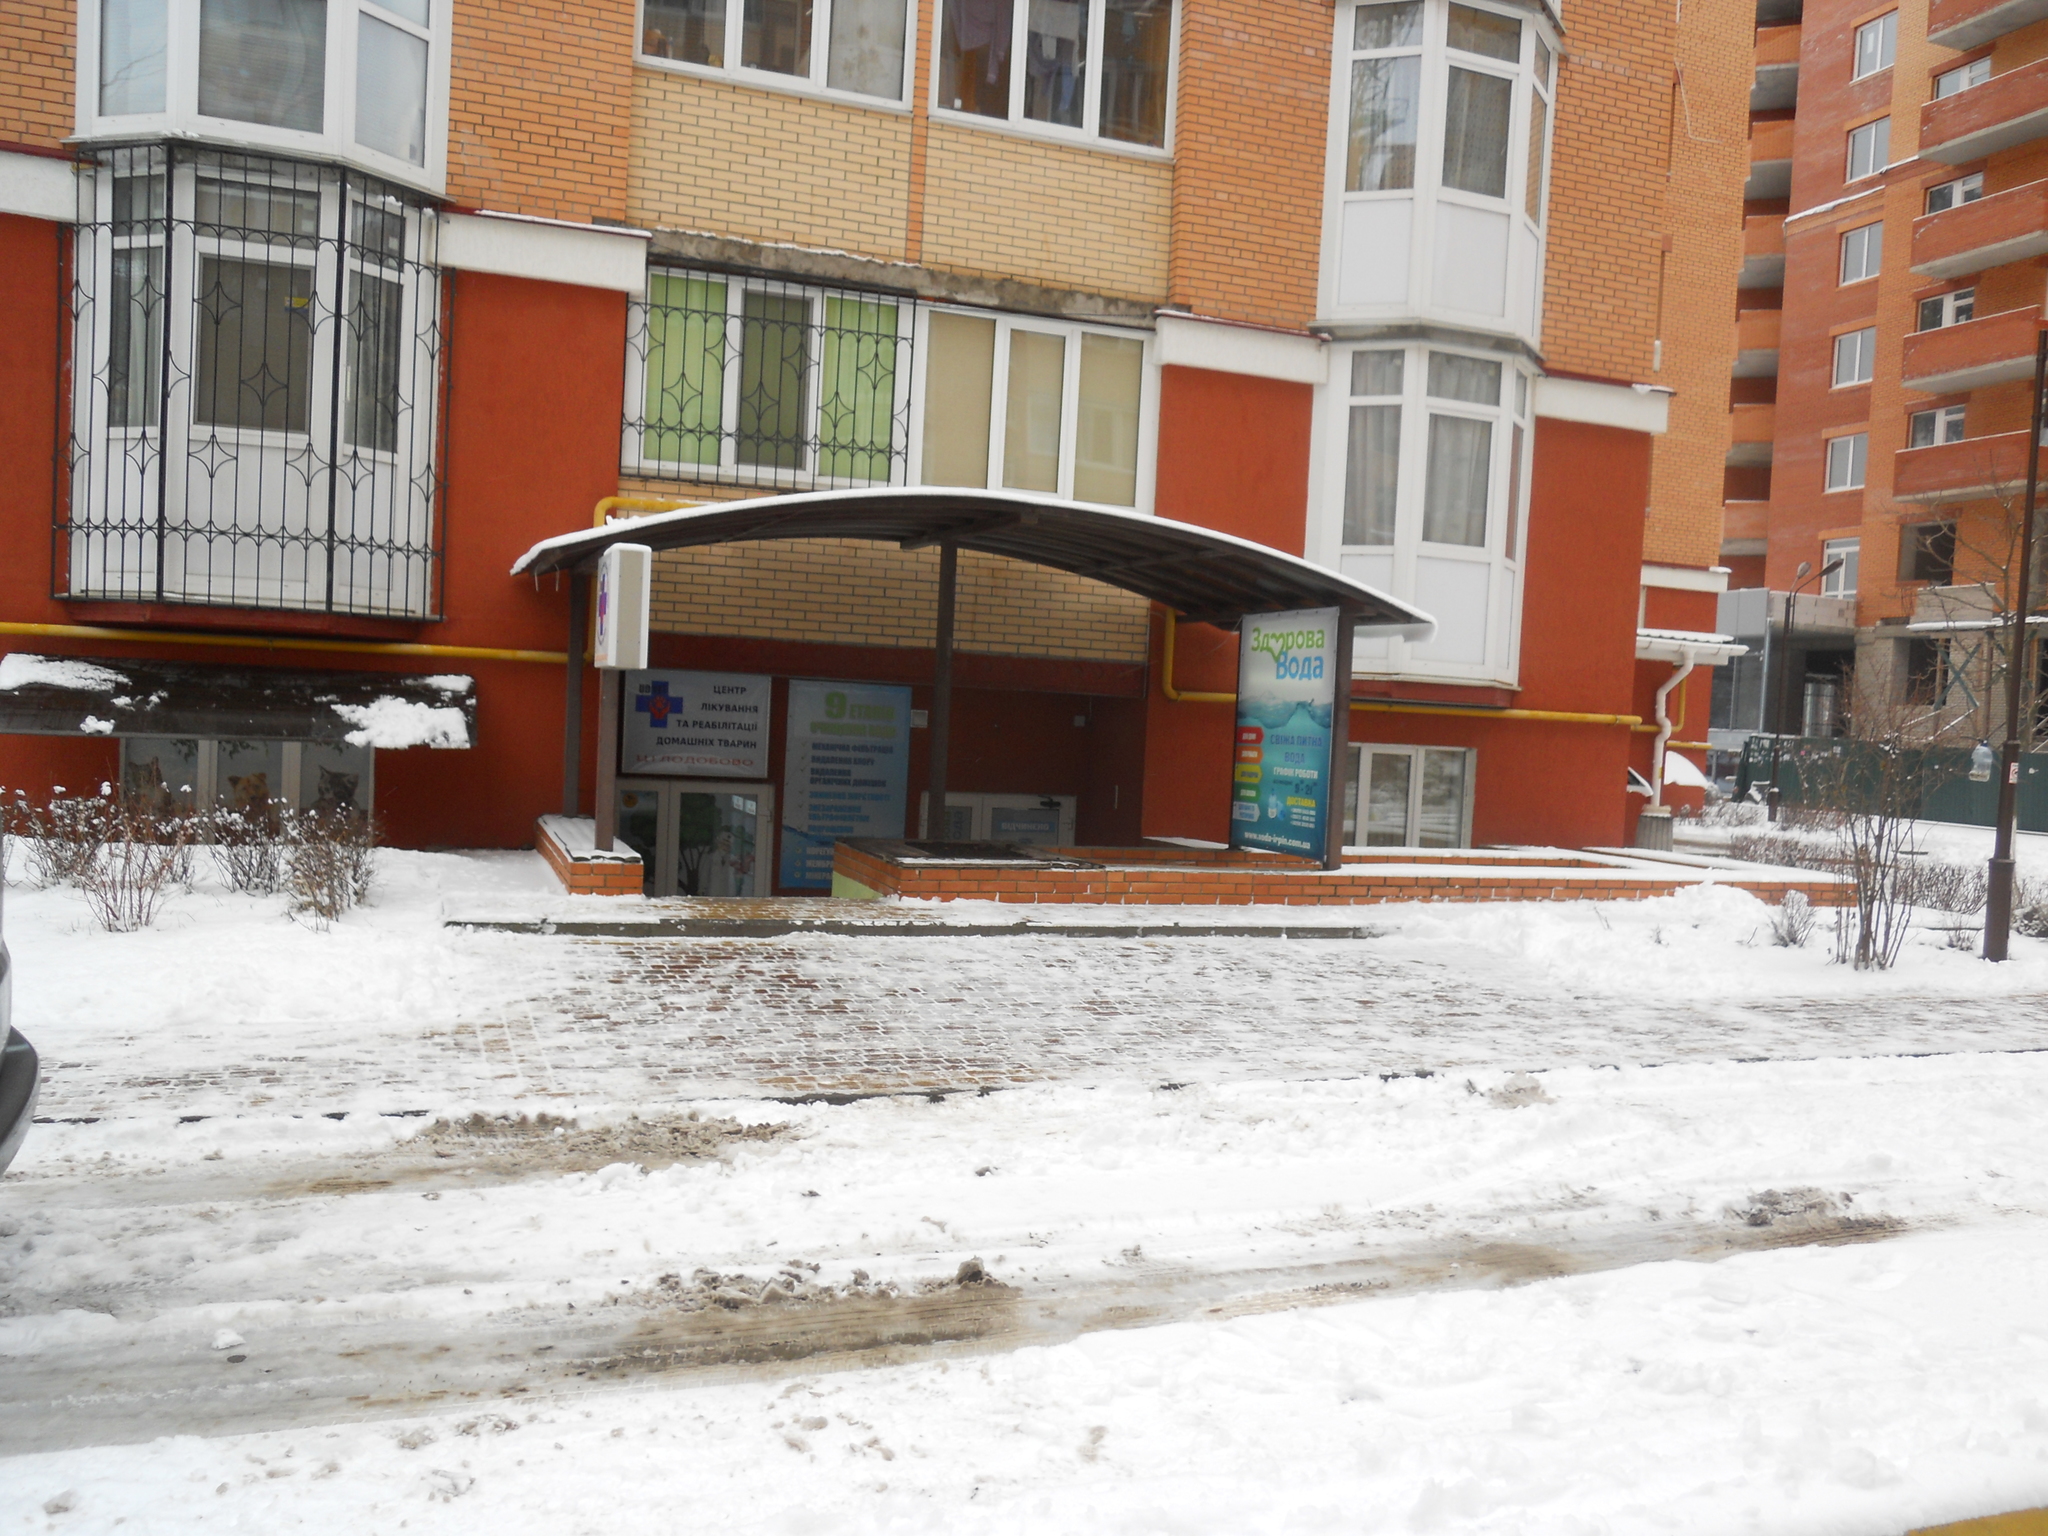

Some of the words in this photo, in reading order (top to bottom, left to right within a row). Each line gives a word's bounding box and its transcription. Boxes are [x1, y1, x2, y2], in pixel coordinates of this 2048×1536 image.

[1276, 650, 1324, 681] Вода
[713, 685, 747, 695] ЦЕНТР
[701, 703, 758, 714] ЛІКУВАННЯ
[825, 690, 847, 719] 9
[676, 719, 689, 728] ТА
[692, 720, 758, 732] РЕАБІЛІТАЦІЇ
[656, 736, 715, 747] ДОМАШНІХ
[717, 739, 757, 749] ТВАРИН
[1270, 734, 1295, 745] СВІЖА
[1296, 735, 1323, 747] ПИТНА
[636, 754, 754, 767] ЦІЛОДОБОВО
[1284, 751, 1305, 764] ВОДА
[1273, 766, 1295, 777] ГРАФІК
[1294, 768, 1319, 780] РОБОТИ
[1286, 796, 1316, 808] ДОСТАВКА
